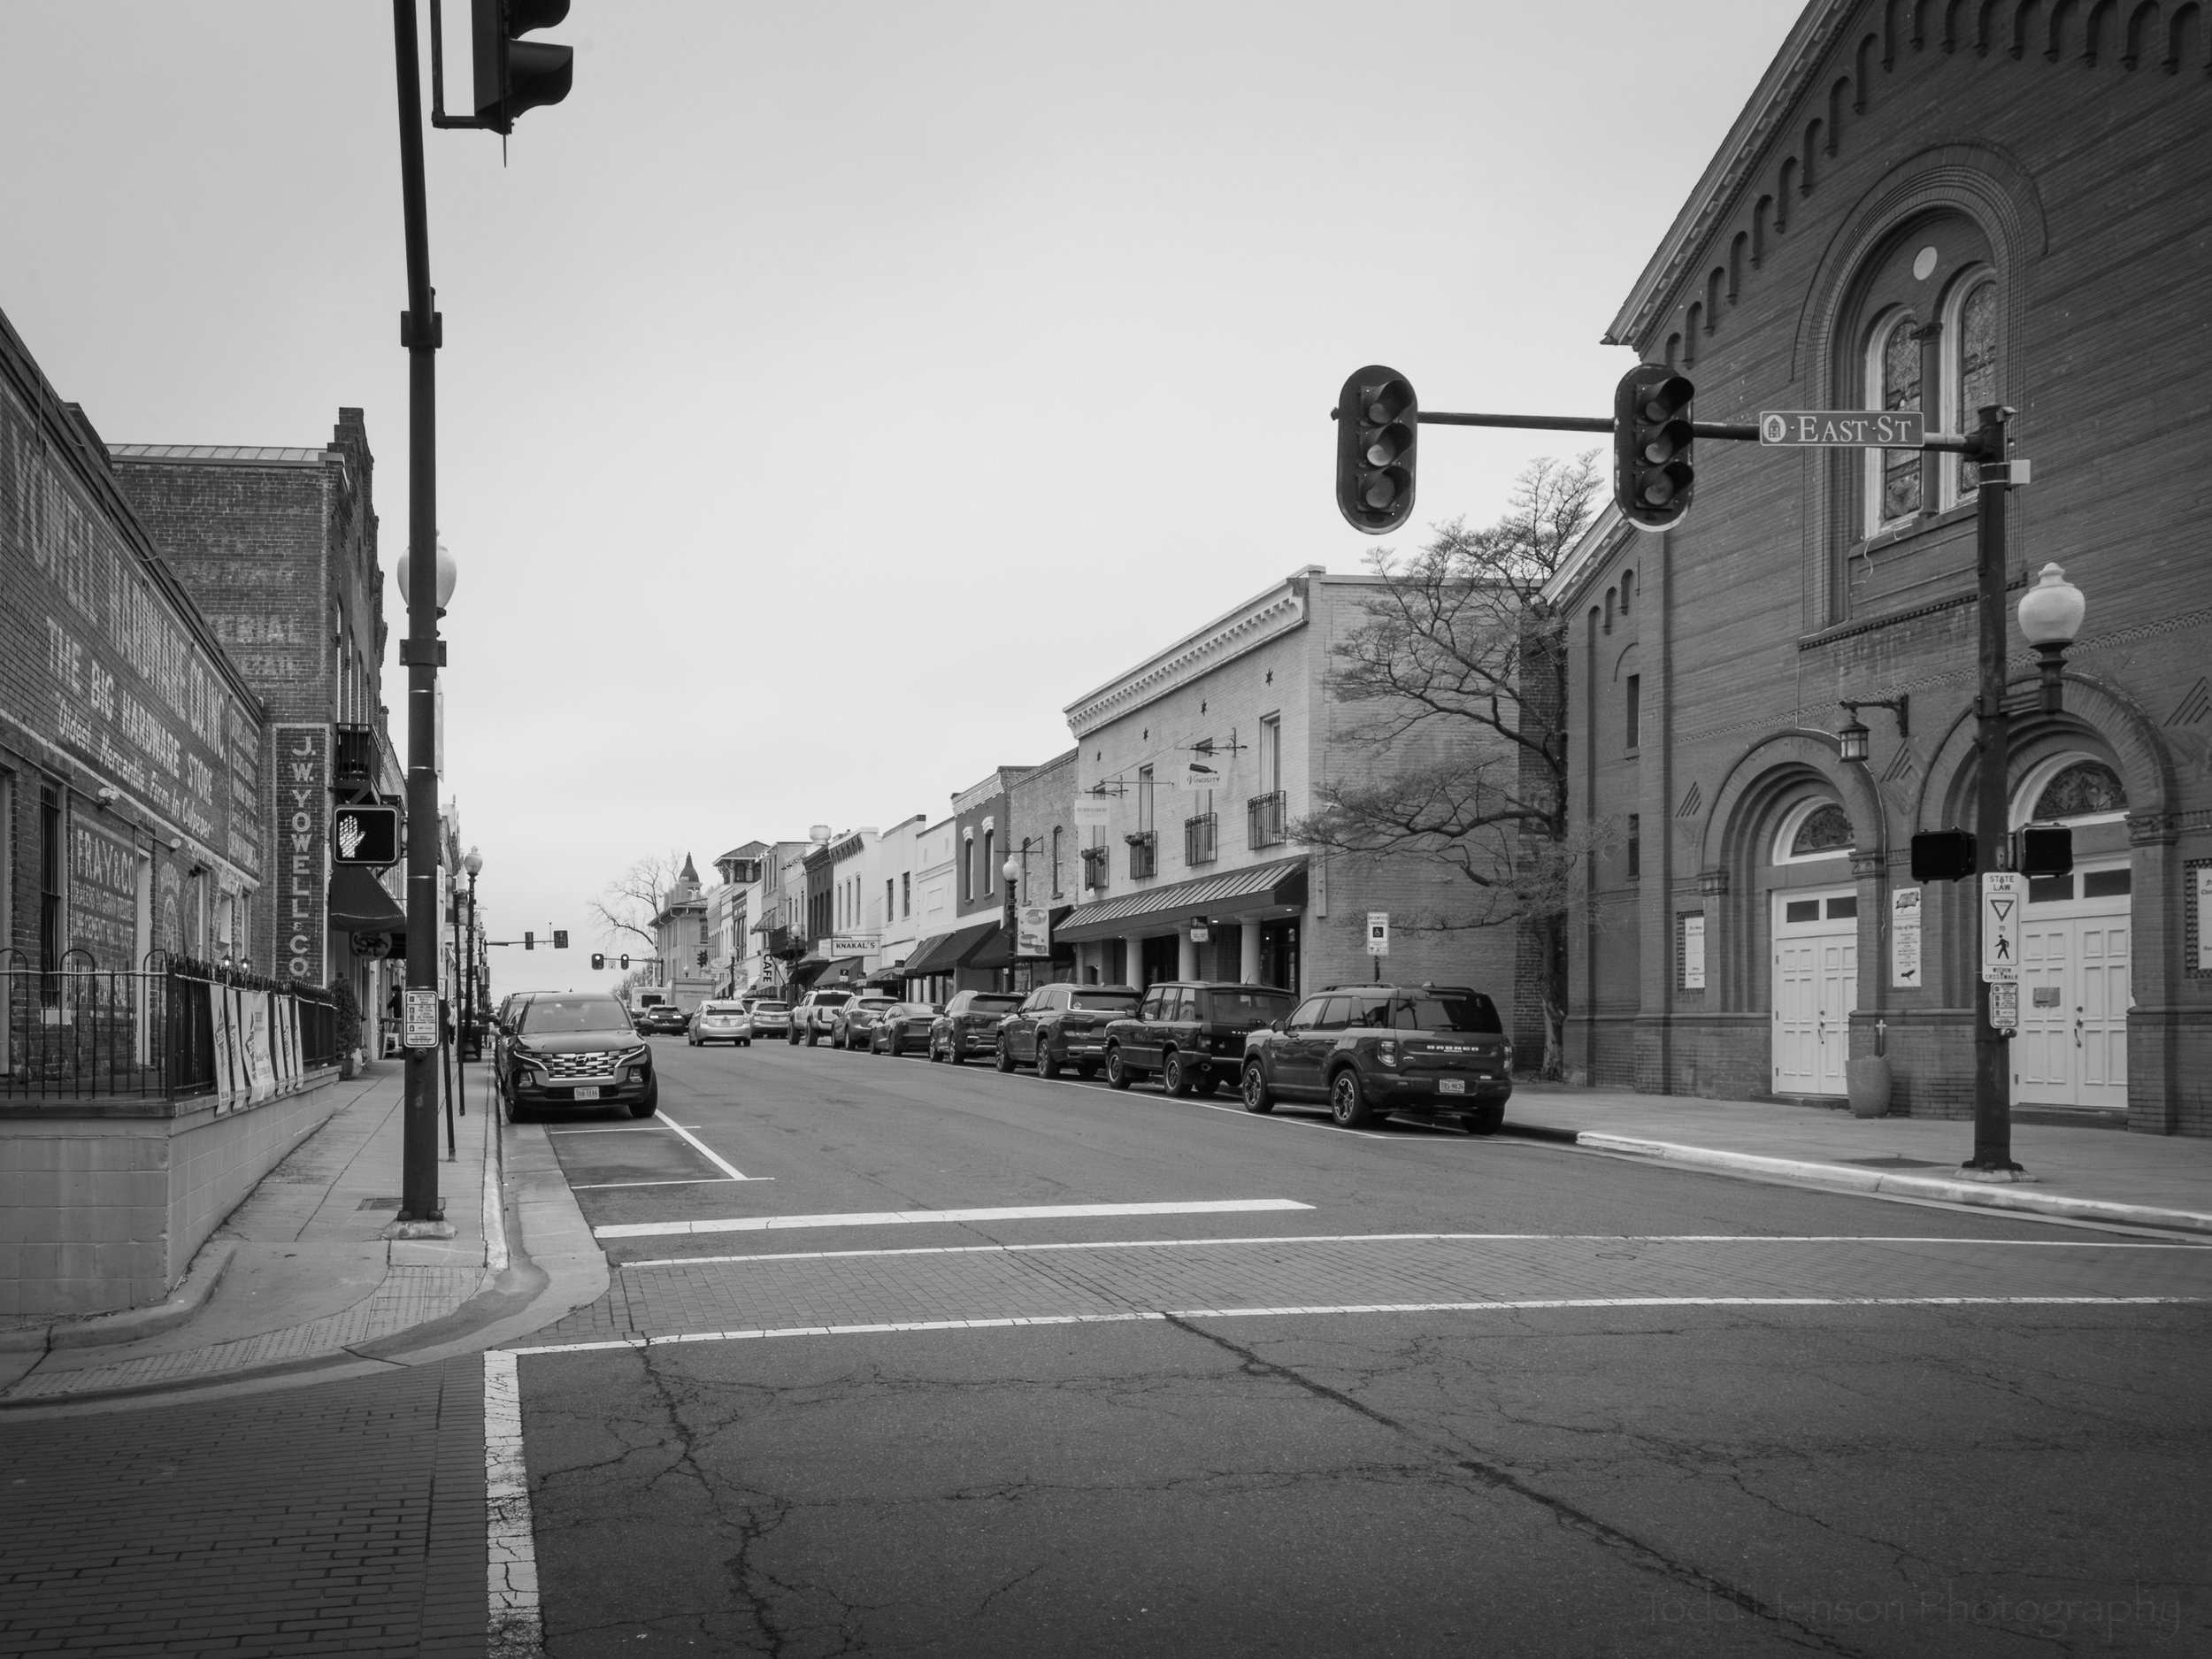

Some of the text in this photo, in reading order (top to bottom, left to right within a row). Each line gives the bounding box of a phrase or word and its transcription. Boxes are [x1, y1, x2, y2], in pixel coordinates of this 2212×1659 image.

[1797, 415, 1912, 442] EAST ST
[108, 548, 186, 722] HARDWARE
[46, 615, 82, 695] THE
[90, 659, 115, 722] BIG
[121, 689, 180, 780] HARDWARE
[187, 752, 213, 807] STORE
[99, 732, 145, 794] Mercantile
[149, 771, 170, 811] Firm
[77, 828, 114, 886] FRAY
[763, 954, 772, 982] CAFE
